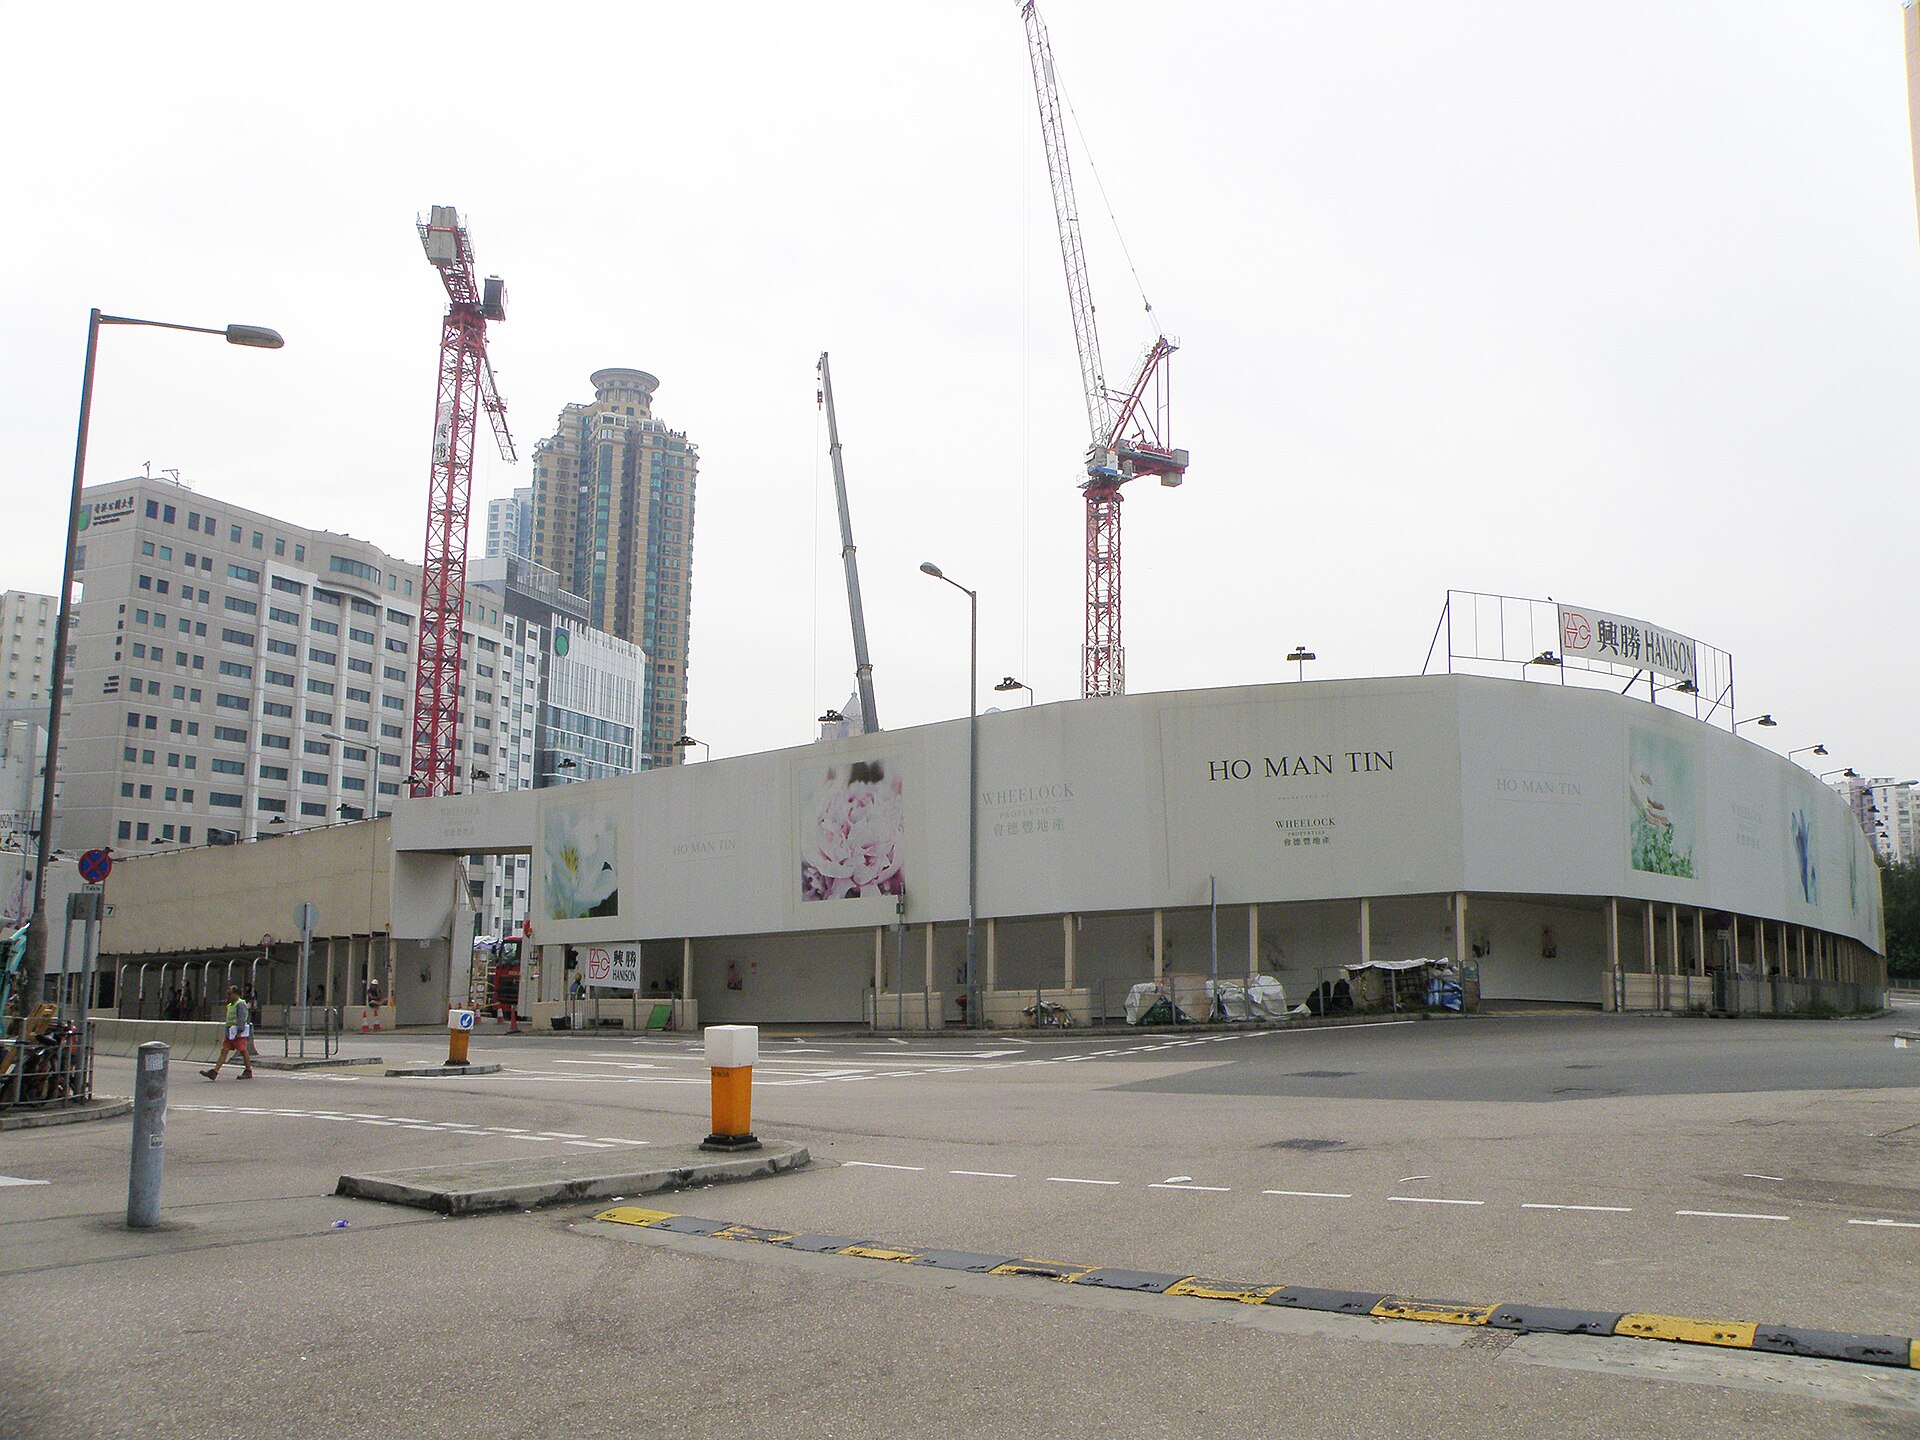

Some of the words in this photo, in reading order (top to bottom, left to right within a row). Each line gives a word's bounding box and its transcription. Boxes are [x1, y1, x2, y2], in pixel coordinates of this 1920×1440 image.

[1597, 619, 1641, 661] 興勝
[1644, 629, 1694, 678] HANISON
[1208, 759, 1251, 781] HO
[1264, 755, 1333, 778] MAN
[1345, 750, 1394, 773] TIN
[982, 783, 1074, 804] WHEELOCK
[1497, 779, 1517, 792] HO
[1522, 780, 1554, 794] MAN
[1559, 782, 1581, 795] TIN
[1275, 817, 1336, 828] WHEELOCK
[673, 844, 688, 856] HO
[691, 840, 715, 854] MAN
[718, 839, 736, 850] TIN
[613, 950, 637, 969] 興勝
[612, 969, 637, 982] HANISON
